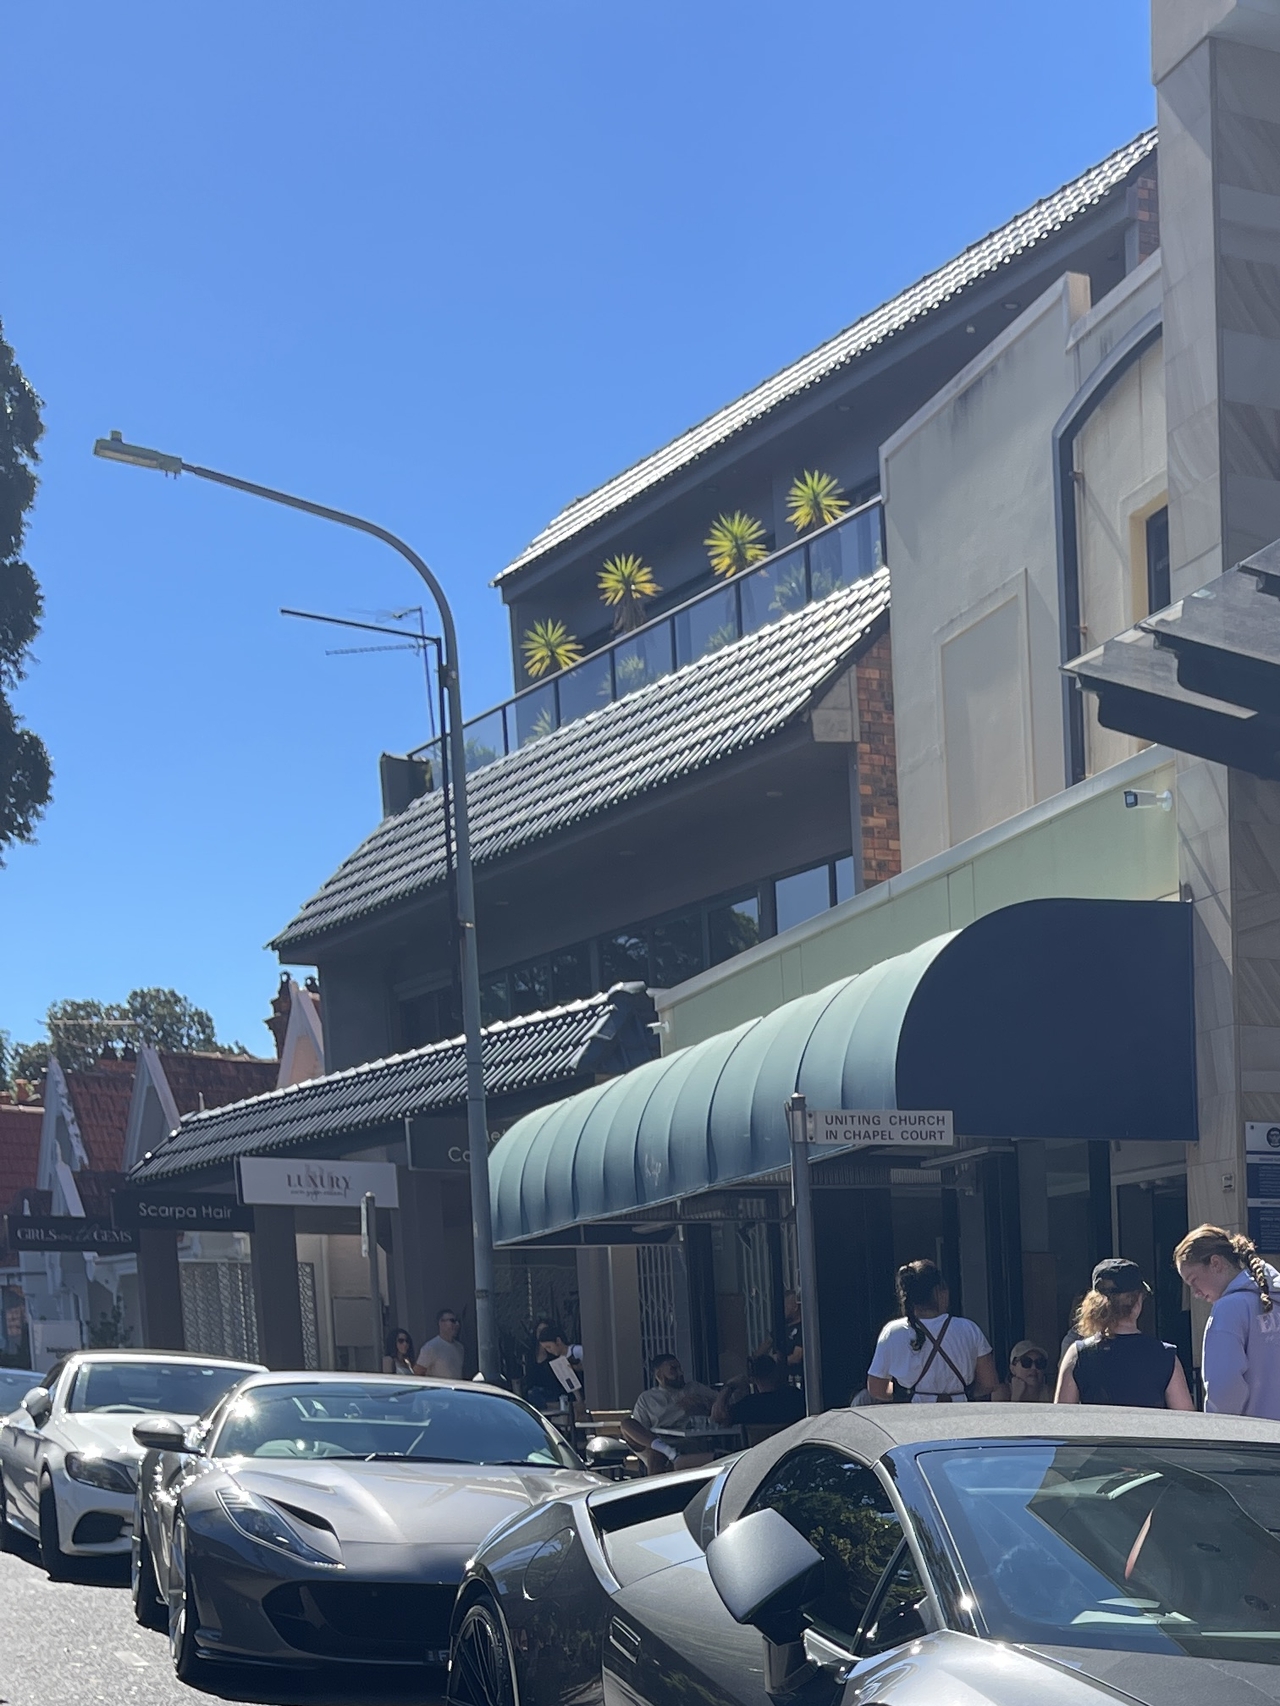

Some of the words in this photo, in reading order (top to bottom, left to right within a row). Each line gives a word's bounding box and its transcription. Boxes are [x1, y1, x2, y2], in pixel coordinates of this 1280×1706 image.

[824, 1114, 881, 1126] UNITING
[888, 1114, 946, 1126] CHURCH
[825, 1129, 838, 1141] IN
[843, 1129, 895, 1141] CHAPEL
[900, 1129, 946, 1141] COURT
[286, 1173, 352, 1191] LUXURY
[138, 1202, 197, 1219] Scarpa
[201, 1205, 232, 1219] Hair
[16, 1227, 58, 1241] GIRLS
[92, 1229, 133, 1242] GEMS
